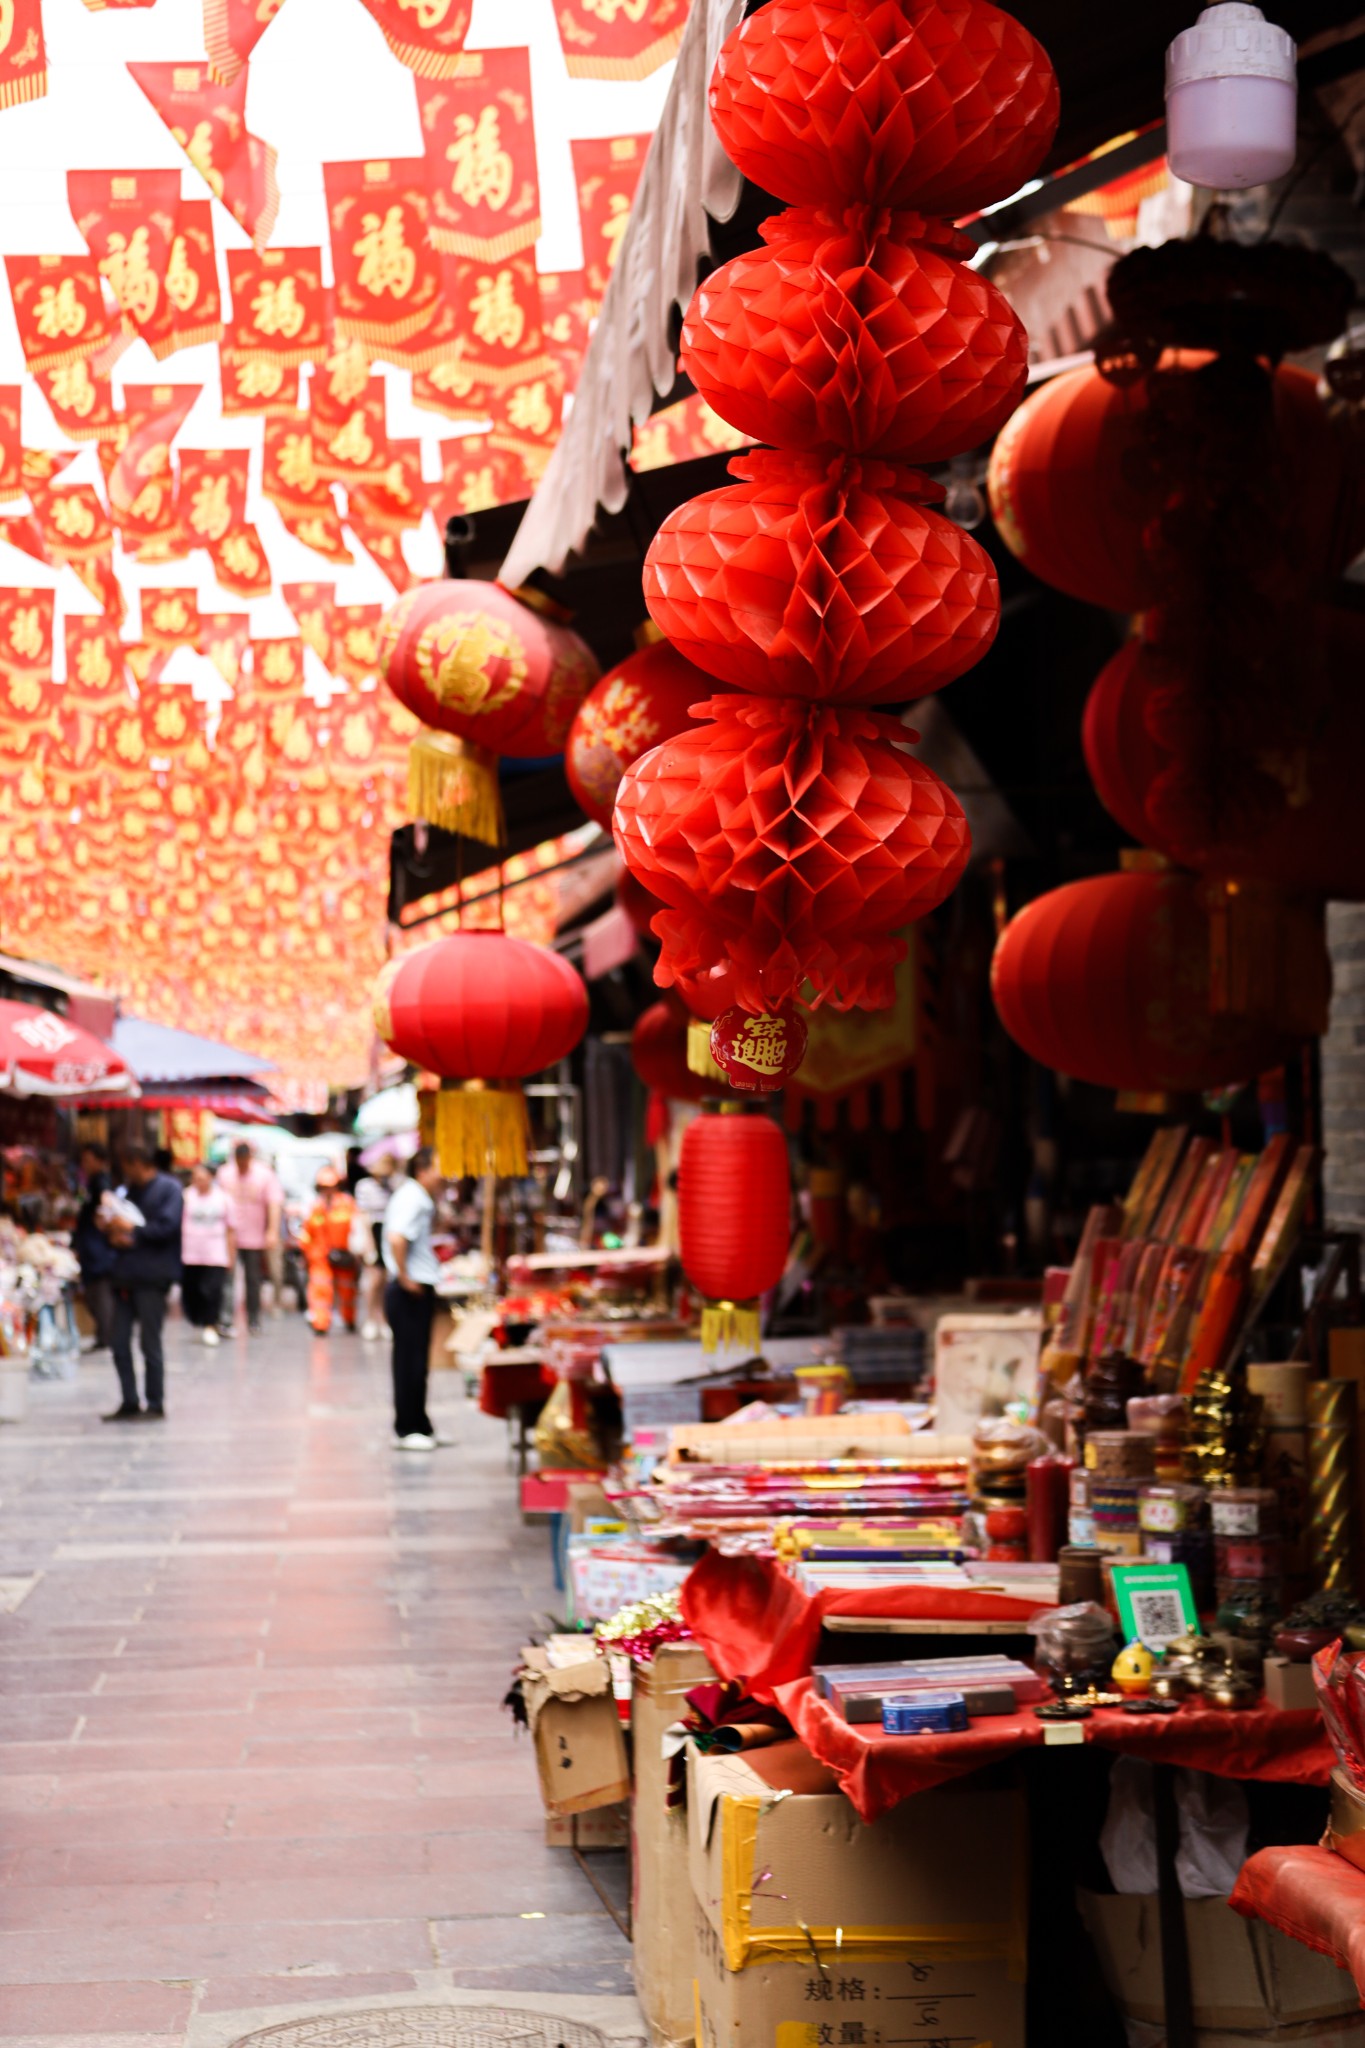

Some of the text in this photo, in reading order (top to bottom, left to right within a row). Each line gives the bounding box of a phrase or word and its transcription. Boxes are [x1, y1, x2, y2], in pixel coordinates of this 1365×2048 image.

[447, 105, 513, 211] 福
[353, 205, 415, 299] 福
[32, 278, 86, 338] 福
[250, 276, 305, 338] 福
[469, 270, 524, 348] 福
